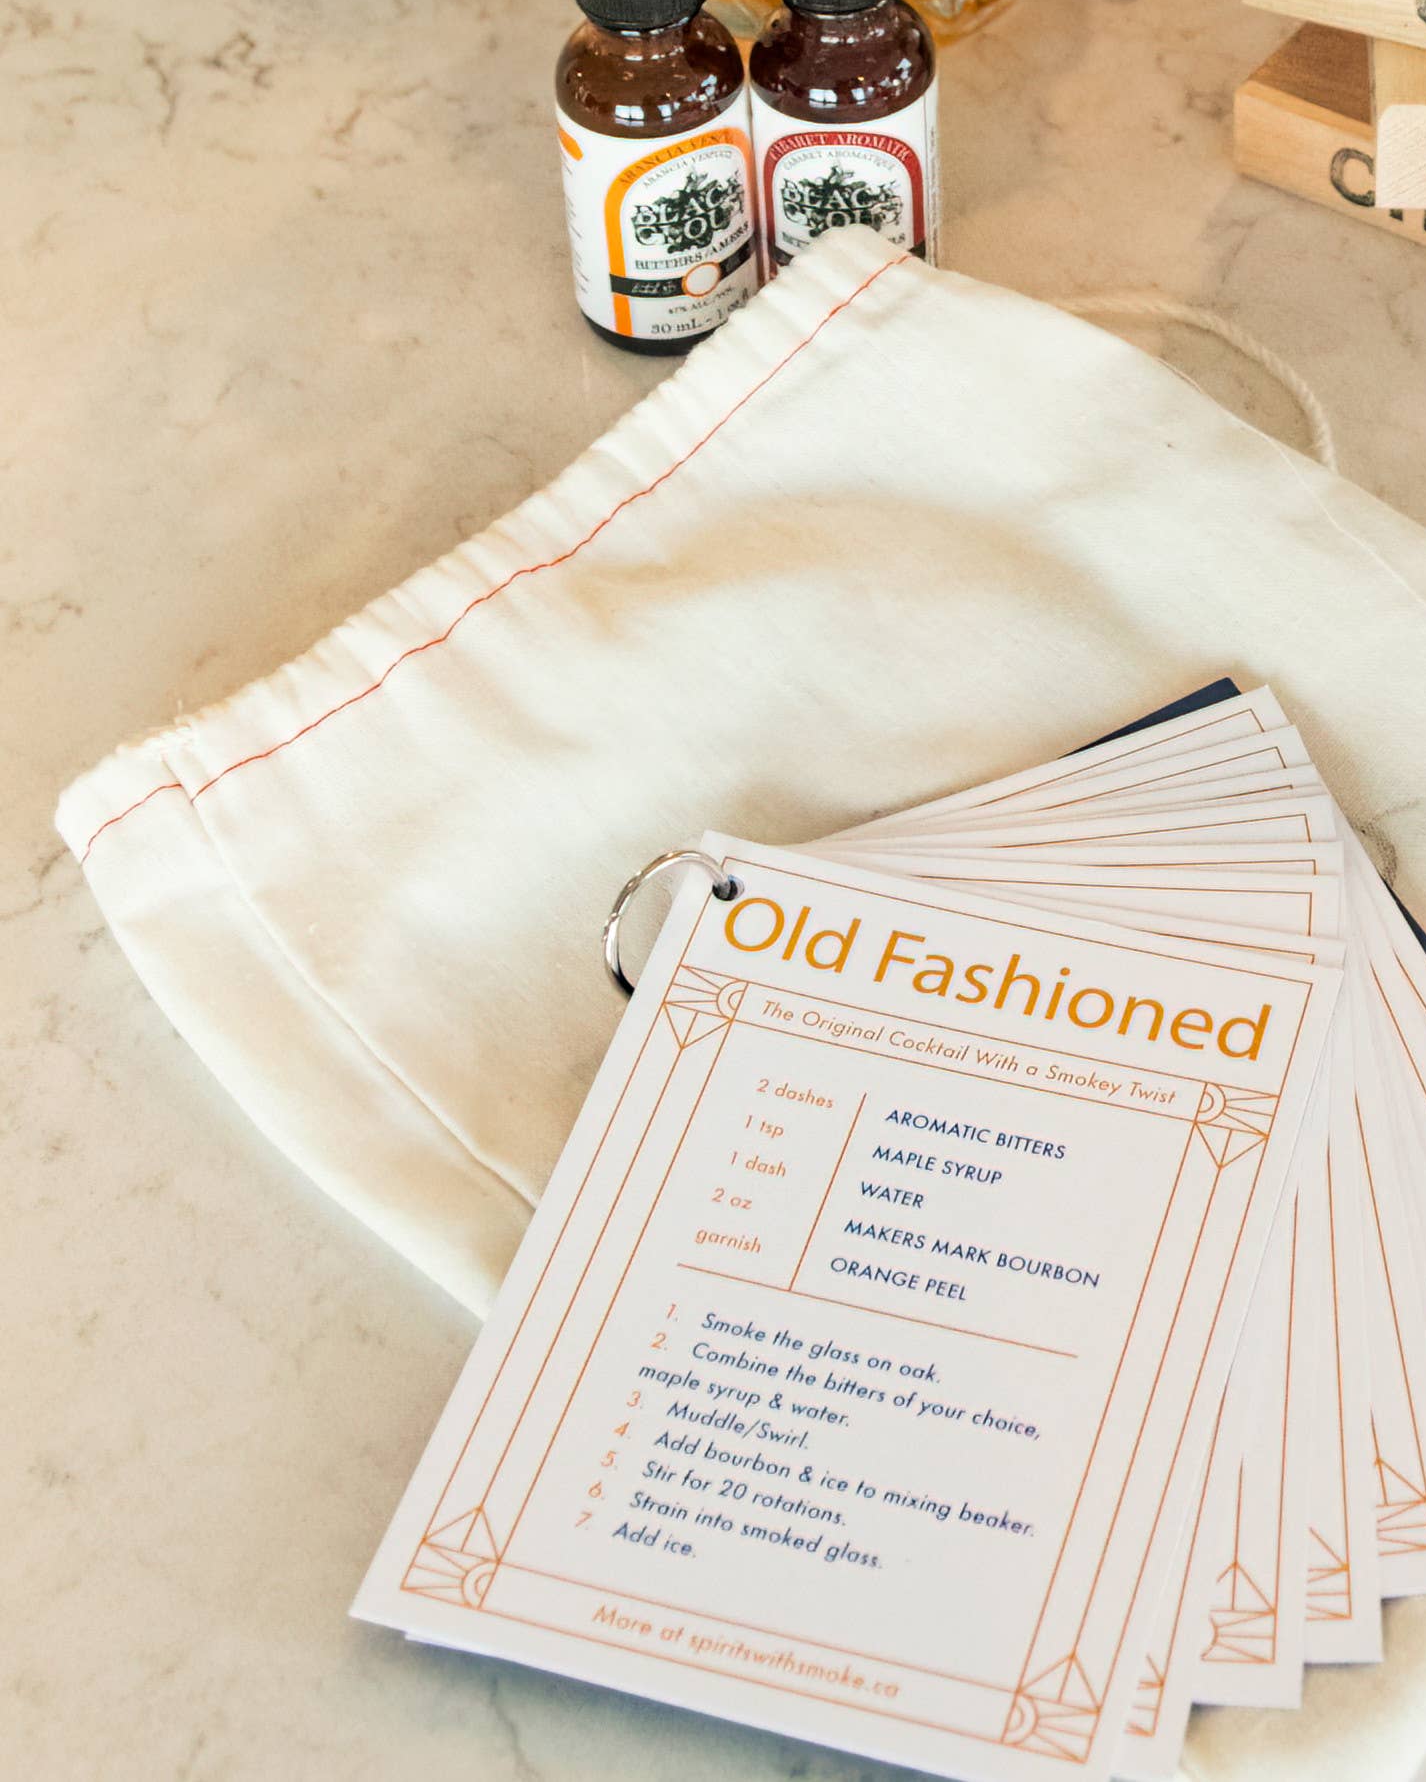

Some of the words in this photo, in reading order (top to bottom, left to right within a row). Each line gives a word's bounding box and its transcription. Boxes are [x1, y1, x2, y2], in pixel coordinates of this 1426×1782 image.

[723, 896, 862, 974] Old
[872, 929, 1272, 1062] Fashioned
[761, 998, 794, 1022] The
[800, 1009, 886, 1043] Original
[887, 1029, 971, 1062] Cocktail
[975, 1048, 1019, 1073] With
[1024, 1064, 1039, 1077] a
[1043, 1063, 1123, 1098] Smokey
[1128, 1079, 1176, 1104] Twist
[755, 1077, 770, 1094] 2
[773, 1081, 834, 1109] dashes
[744, 1113, 753, 1129] 1
[758, 1119, 785, 1139] tsp
[884, 1108, 991, 1144] AROMATIC
[994, 1131, 1066, 1160] BITTERS
[729, 1150, 739, 1166] 1
[743, 1154, 787, 1178] dash
[871, 1144, 937, 1172] MAPLE
[940, 1159, 1003, 1185] SYRUP
[710, 1186, 726, 1203] 2
[728, 1194, 753, 1211] oz
[860, 1180, 924, 1209] WATER
[693, 1228, 762, 1254] garnish
[842, 1218, 926, 1250] MAKERS
[929, 1238, 992, 1265] MARK
[995, 1251, 1100, 1288] BOURBON
[829, 1256, 921, 1291] ORANGE
[923, 1277, 966, 1301] PEEL
[700, 1311, 767, 1342] Smoke
[771, 1328, 804, 1351] the
[806, 1339, 860, 1365] glass
[866, 1356, 892, 1372] on
[897, 1362, 940, 1384] oak.
[637, 1365, 701, 1391] maple
[705, 1381, 761, 1409] syrup
[767, 1391, 783, 1411] &
[790, 1402, 849, 1427] water.
[691, 1341, 779, 1377] Combine
[784, 1363, 817, 1386] the
[822, 1370, 886, 1403] bitters
[891, 1390, 918, 1408] of
[915, 1400, 966, 1420] your
[970, 1407, 1040, 1441] choice,
[665, 1399, 809, 1450] Muddle/Swirl.
[641, 1459, 677, 1483] Stir
[680, 1467, 712, 1491] for
[716, 1477, 749, 1501] 20
[750, 1491, 846, 1526] rotations.
[652, 1430, 702, 1455] Add
[702, 1440, 791, 1479] bourbon
[797, 1464, 813, 1483] &
[818, 1469, 849, 1492] ice
[854, 1479, 877, 1499] to
[882, 1490, 952, 1522] mixing
[957, 1500, 1032, 1535] beaker.
[610, 1520, 662, 1547] Add
[662, 1532, 696, 1558] ice.
[628, 1489, 689, 1521] Strain
[693, 1507, 734, 1532] into
[739, 1522, 824, 1553] smoked
[822, 1540, 882, 1569] glass.
[590, 1603, 653, 1636] More
[658, 1625, 685, 1643] at
[686, 1633, 901, 1699] spiritswithsmoke.ca
